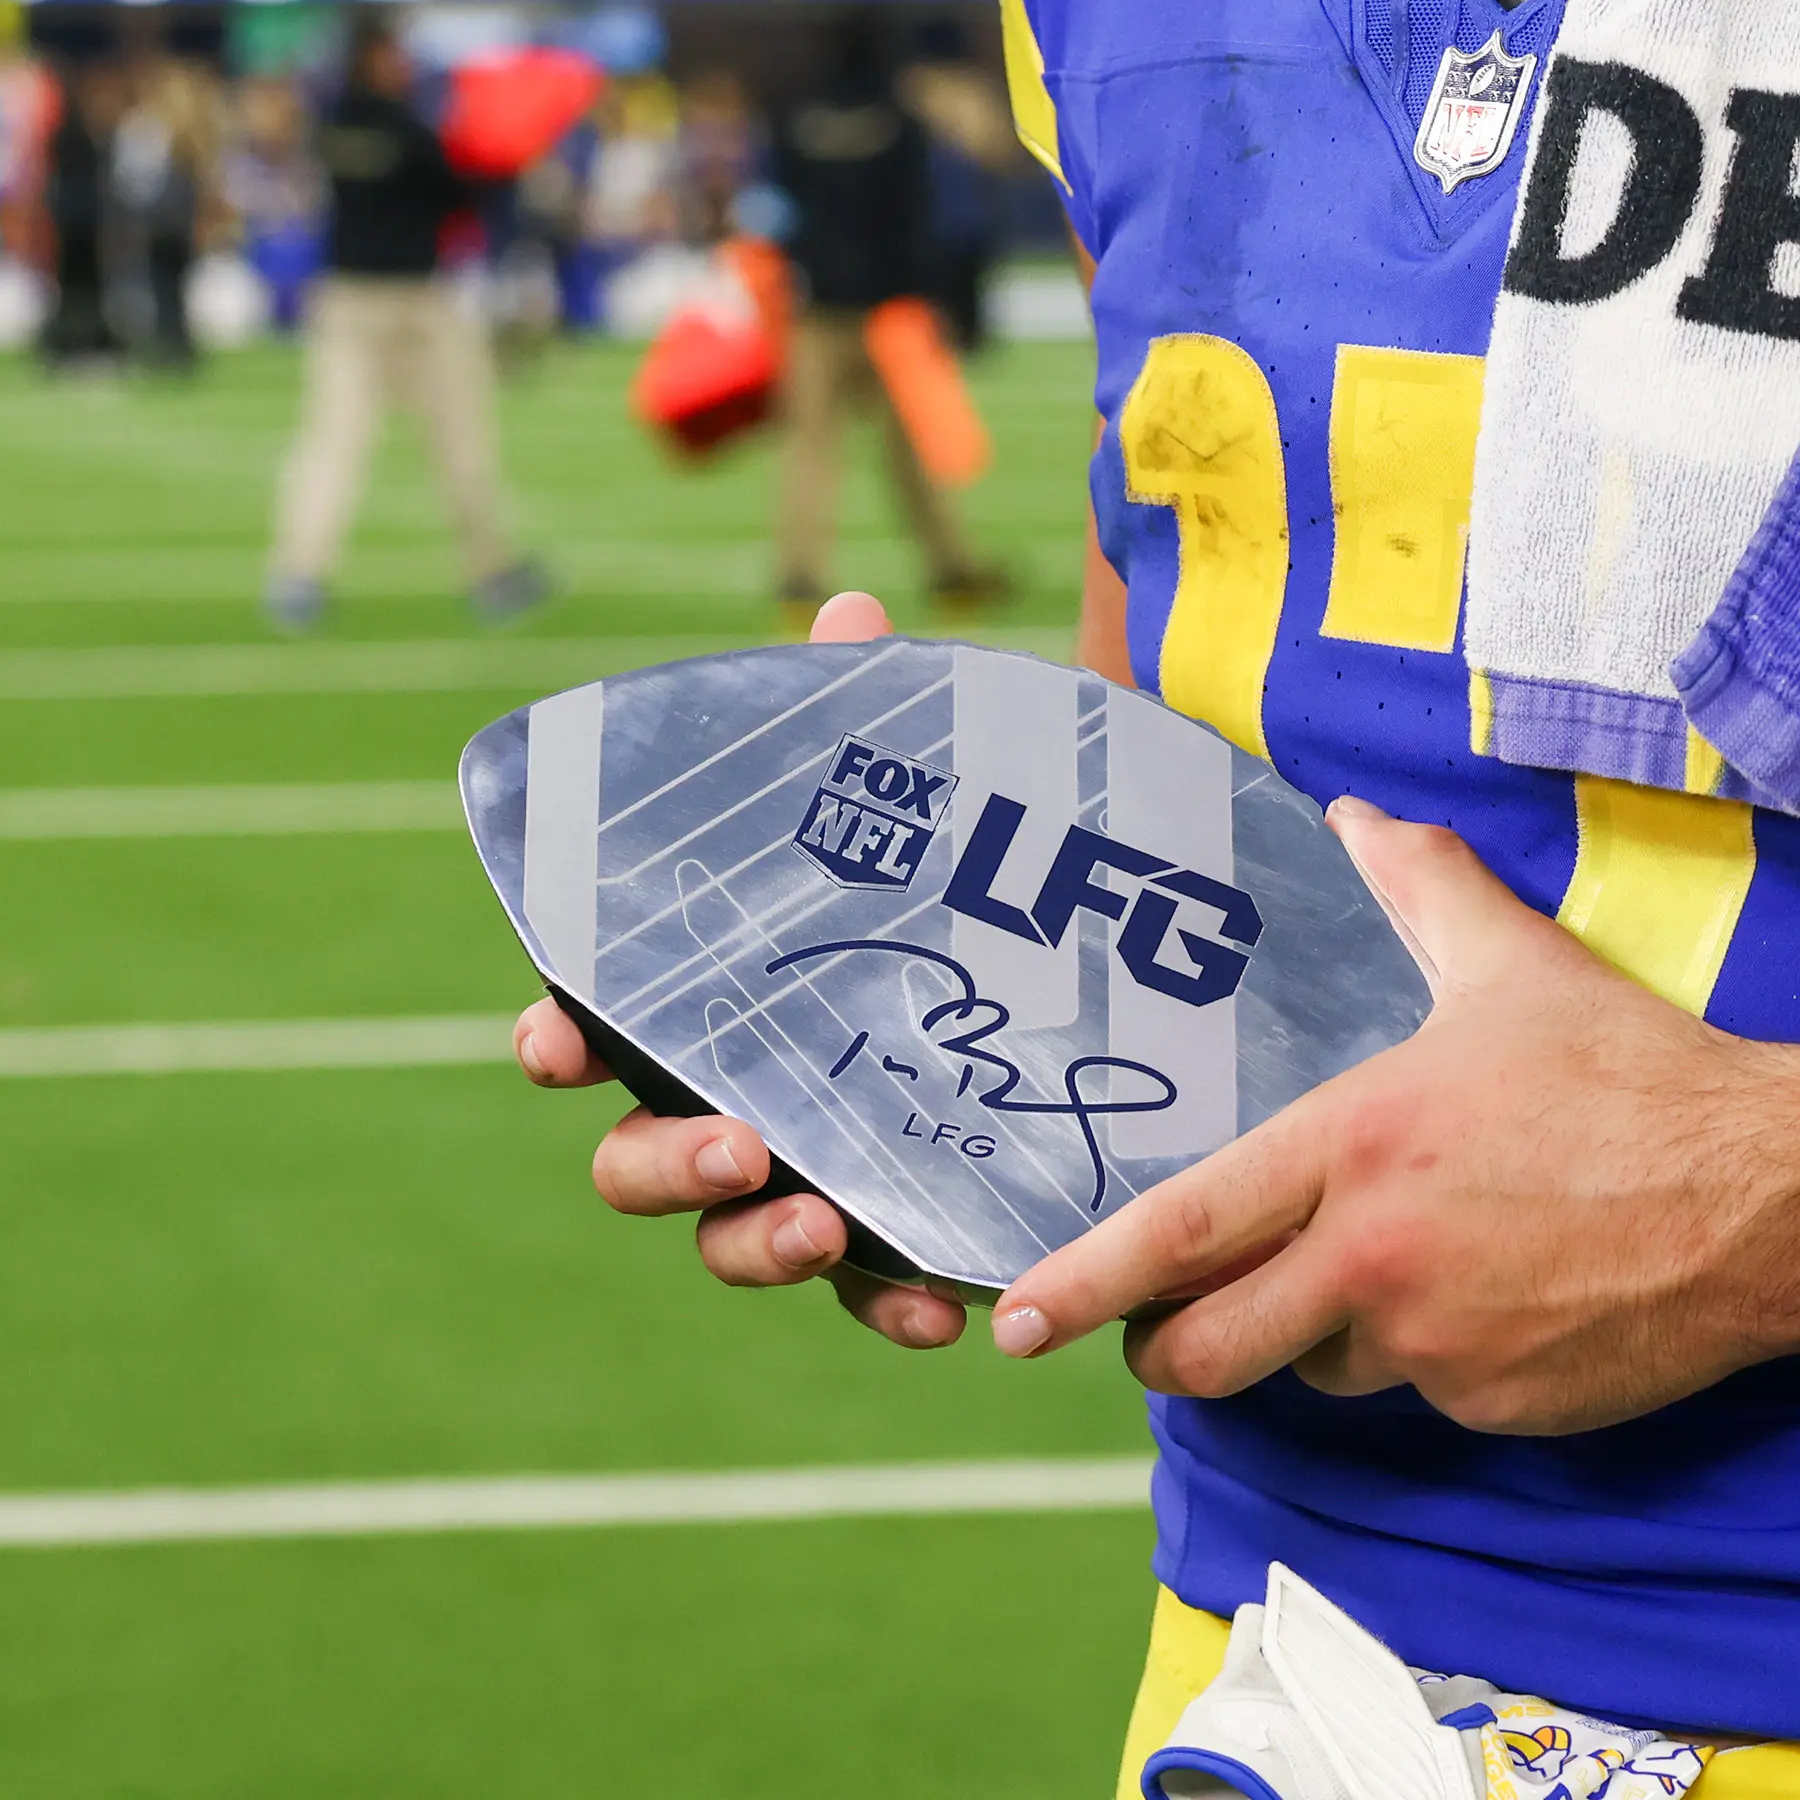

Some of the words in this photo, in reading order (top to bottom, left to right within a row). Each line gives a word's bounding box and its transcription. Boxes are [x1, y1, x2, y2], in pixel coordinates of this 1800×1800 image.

[831, 741, 949, 822] FOX
[802, 794, 915, 881] NFL
[940, 792, 1263, 1006] LFG
[901, 1112, 997, 1159] LFG
